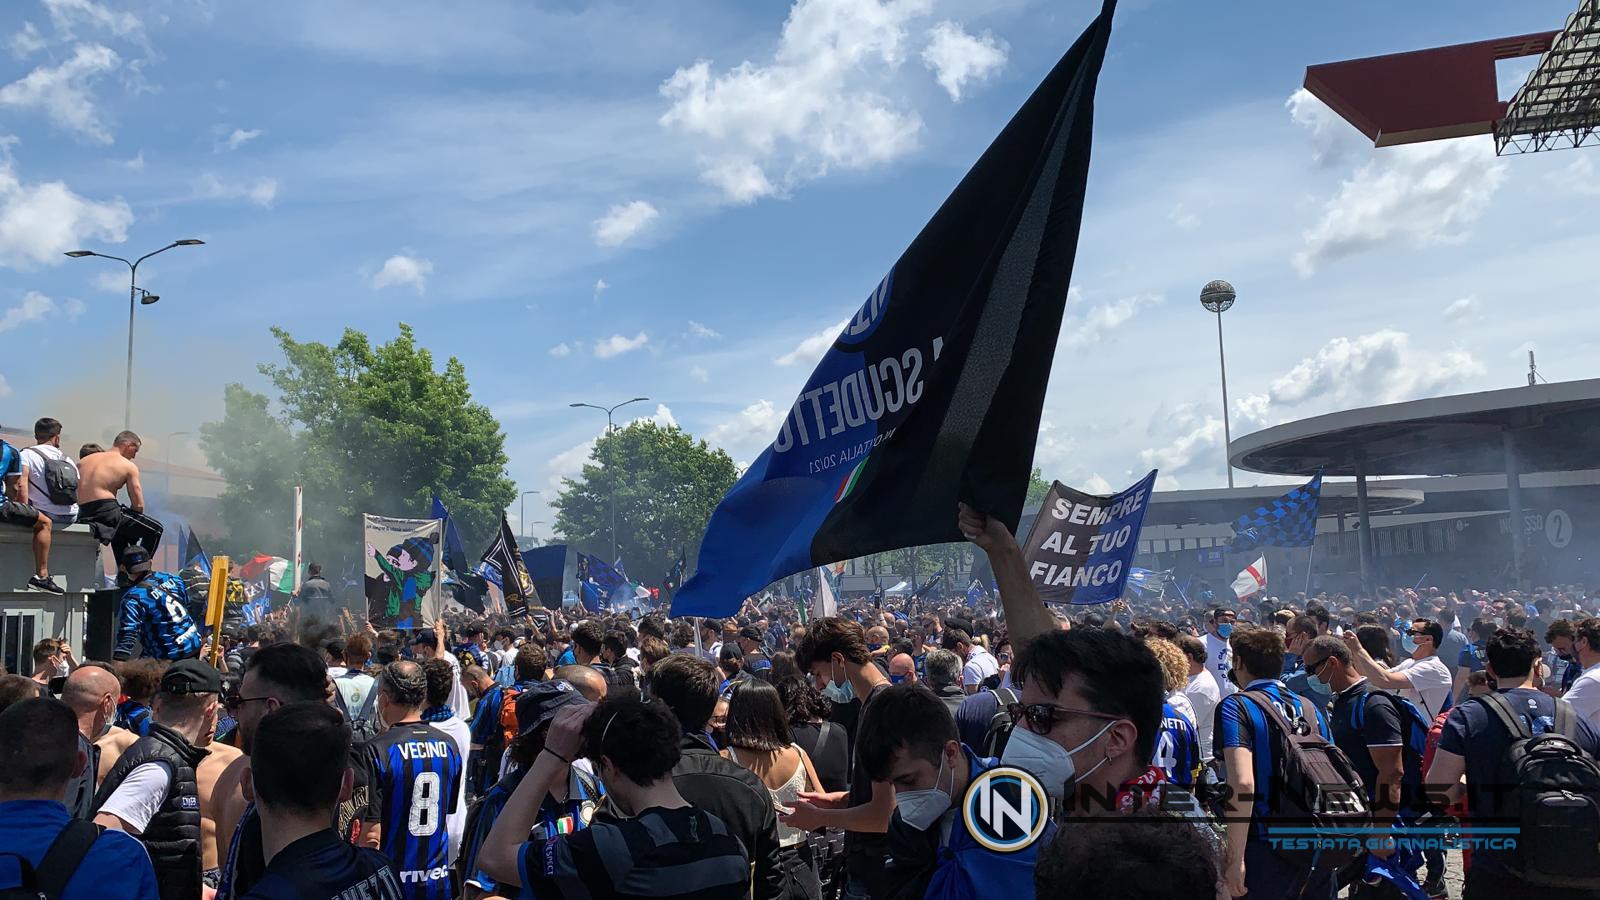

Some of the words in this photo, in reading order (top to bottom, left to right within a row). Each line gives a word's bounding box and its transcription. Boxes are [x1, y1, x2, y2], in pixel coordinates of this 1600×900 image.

[1051, 488, 1146, 526] SEMPRE
[1040, 531, 1078, 555] AL
[1088, 524, 1131, 555] TUO
[1029, 560, 1122, 587] FIANCO
[165, 594, 187, 623] 6
[1160, 717, 1187, 732] NETTI
[398, 741, 448, 760] VECINO
[1152, 731, 1177, 778] 4
[408, 771, 440, 837] 8
